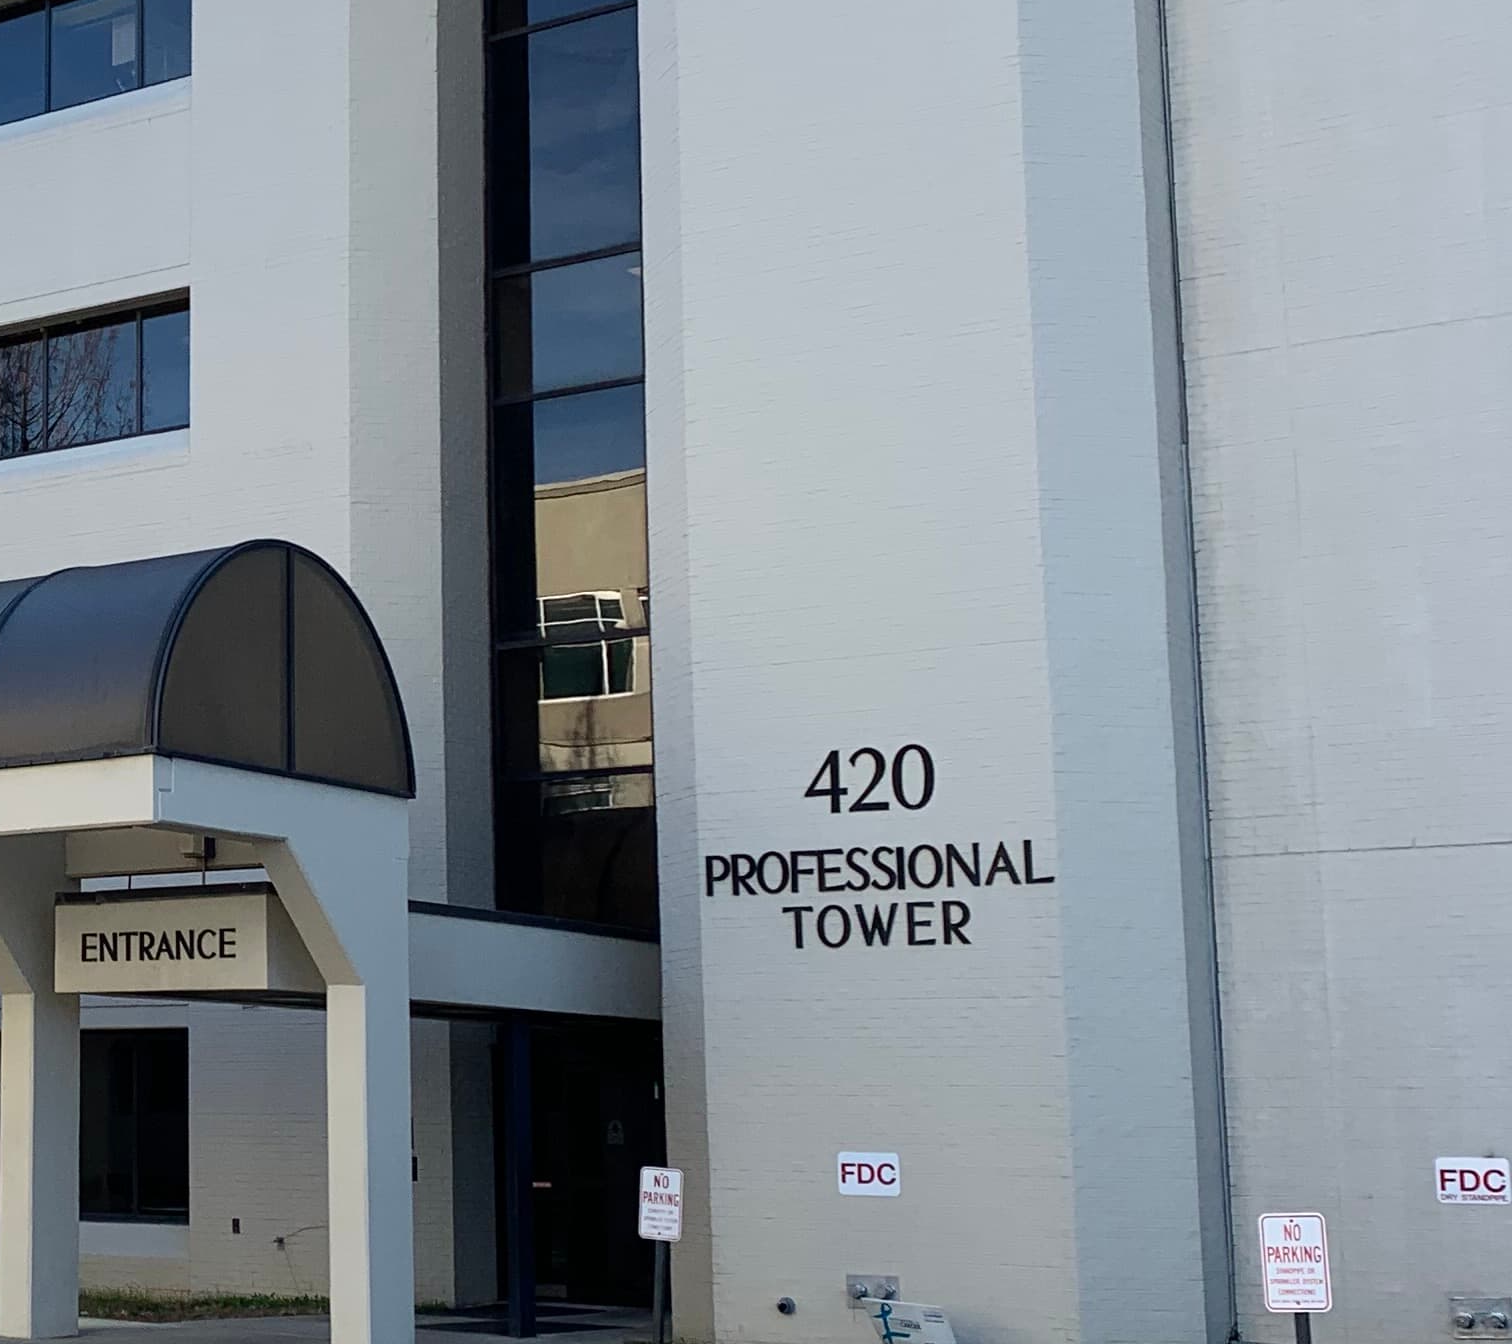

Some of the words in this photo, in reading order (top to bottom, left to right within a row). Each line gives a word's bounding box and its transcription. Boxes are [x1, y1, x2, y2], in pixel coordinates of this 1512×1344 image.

[804, 744, 935, 813] 420
[705, 839, 1055, 896] PROFESSIONAL
[782, 900, 972, 949] TOWER
[81, 928, 236, 962] ENTRANCE
[653, 1175, 669, 1189] NO
[841, 1163, 896, 1185] FDC
[1440, 1169, 1506, 1192] FDC
[643, 1191, 679, 1207] PARKING
[1283, 1224, 1301, 1241] NO
[1267, 1246, 1321, 1263] PARKING
